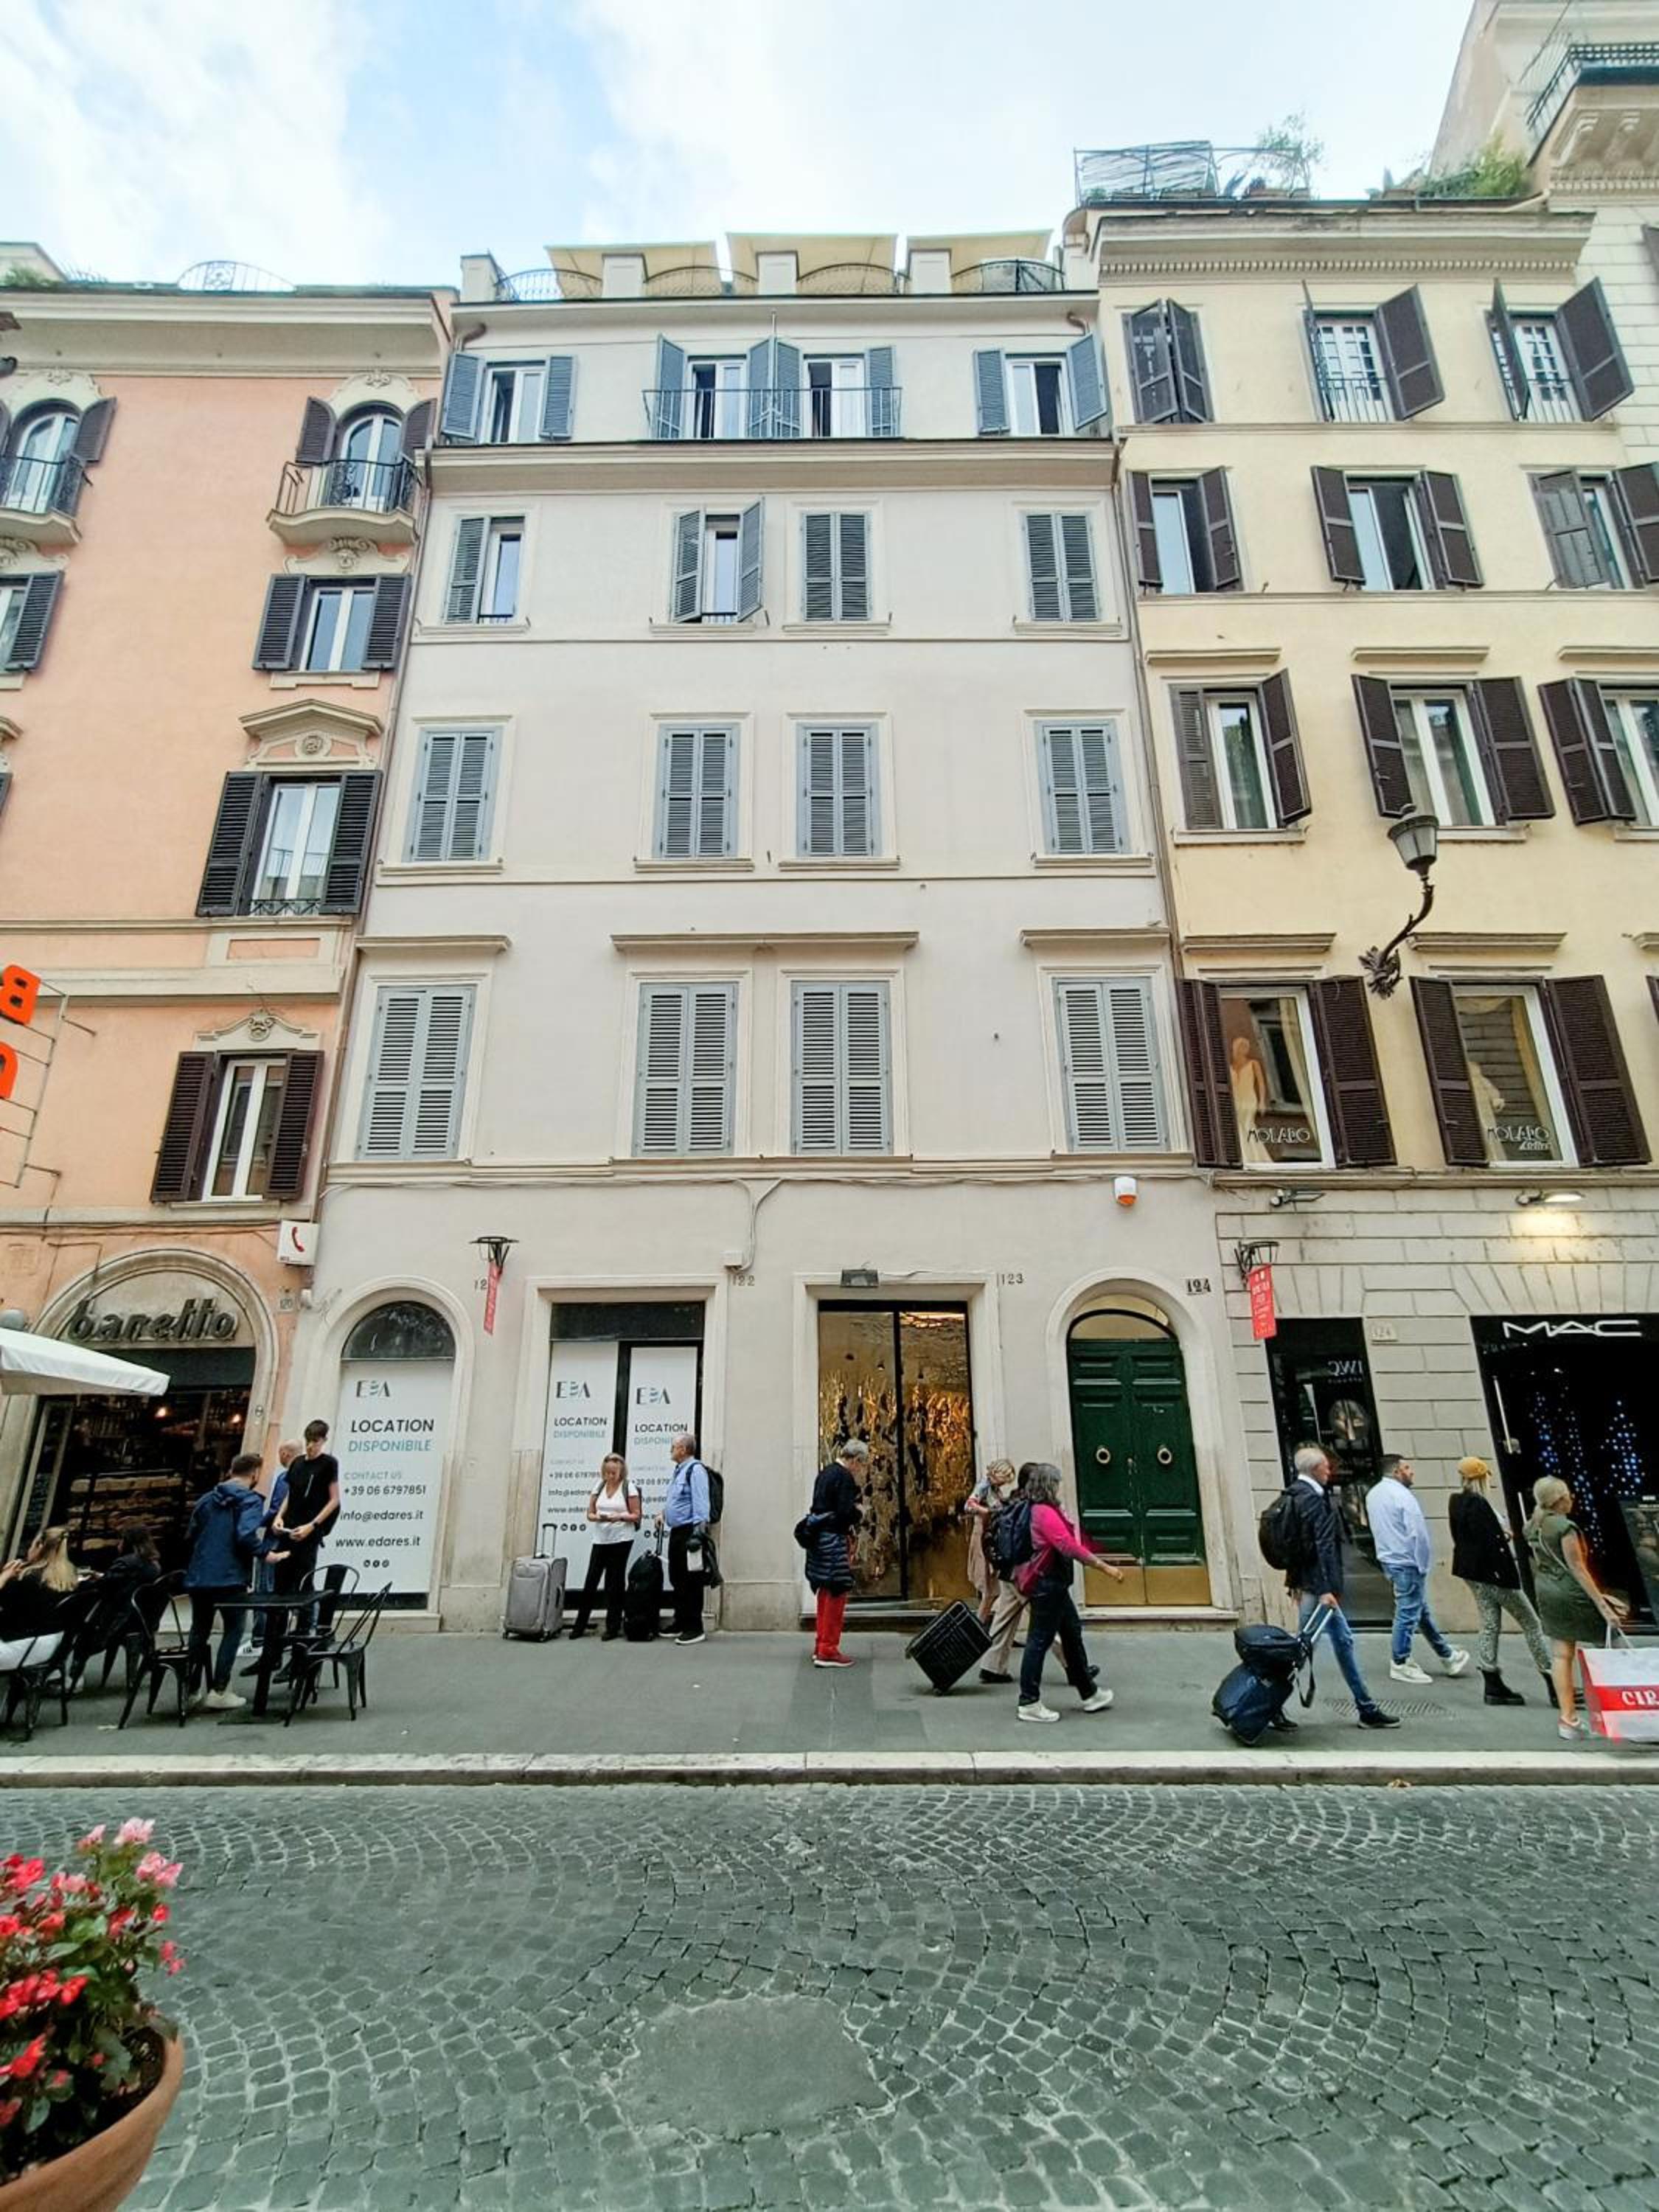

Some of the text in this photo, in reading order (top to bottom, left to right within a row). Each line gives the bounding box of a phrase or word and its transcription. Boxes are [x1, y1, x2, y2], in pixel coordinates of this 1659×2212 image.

[1001, 1273, 1023, 1284] 123
[1187, 1279, 1211, 1293] 124
[68, 1298, 237, 1340] baretto
[350, 1419, 434, 1433] LOCATION
[554, 1416, 607, 1427] LOCATION
[635, 1423, 688, 1433] LOCATION
[366, 1485, 380, 1495] 06
[383, 1484, 426, 1495] 6797851
[340, 1510, 423, 1522] info@edares.it
[335, 1536, 420, 1548] www.edares.it
